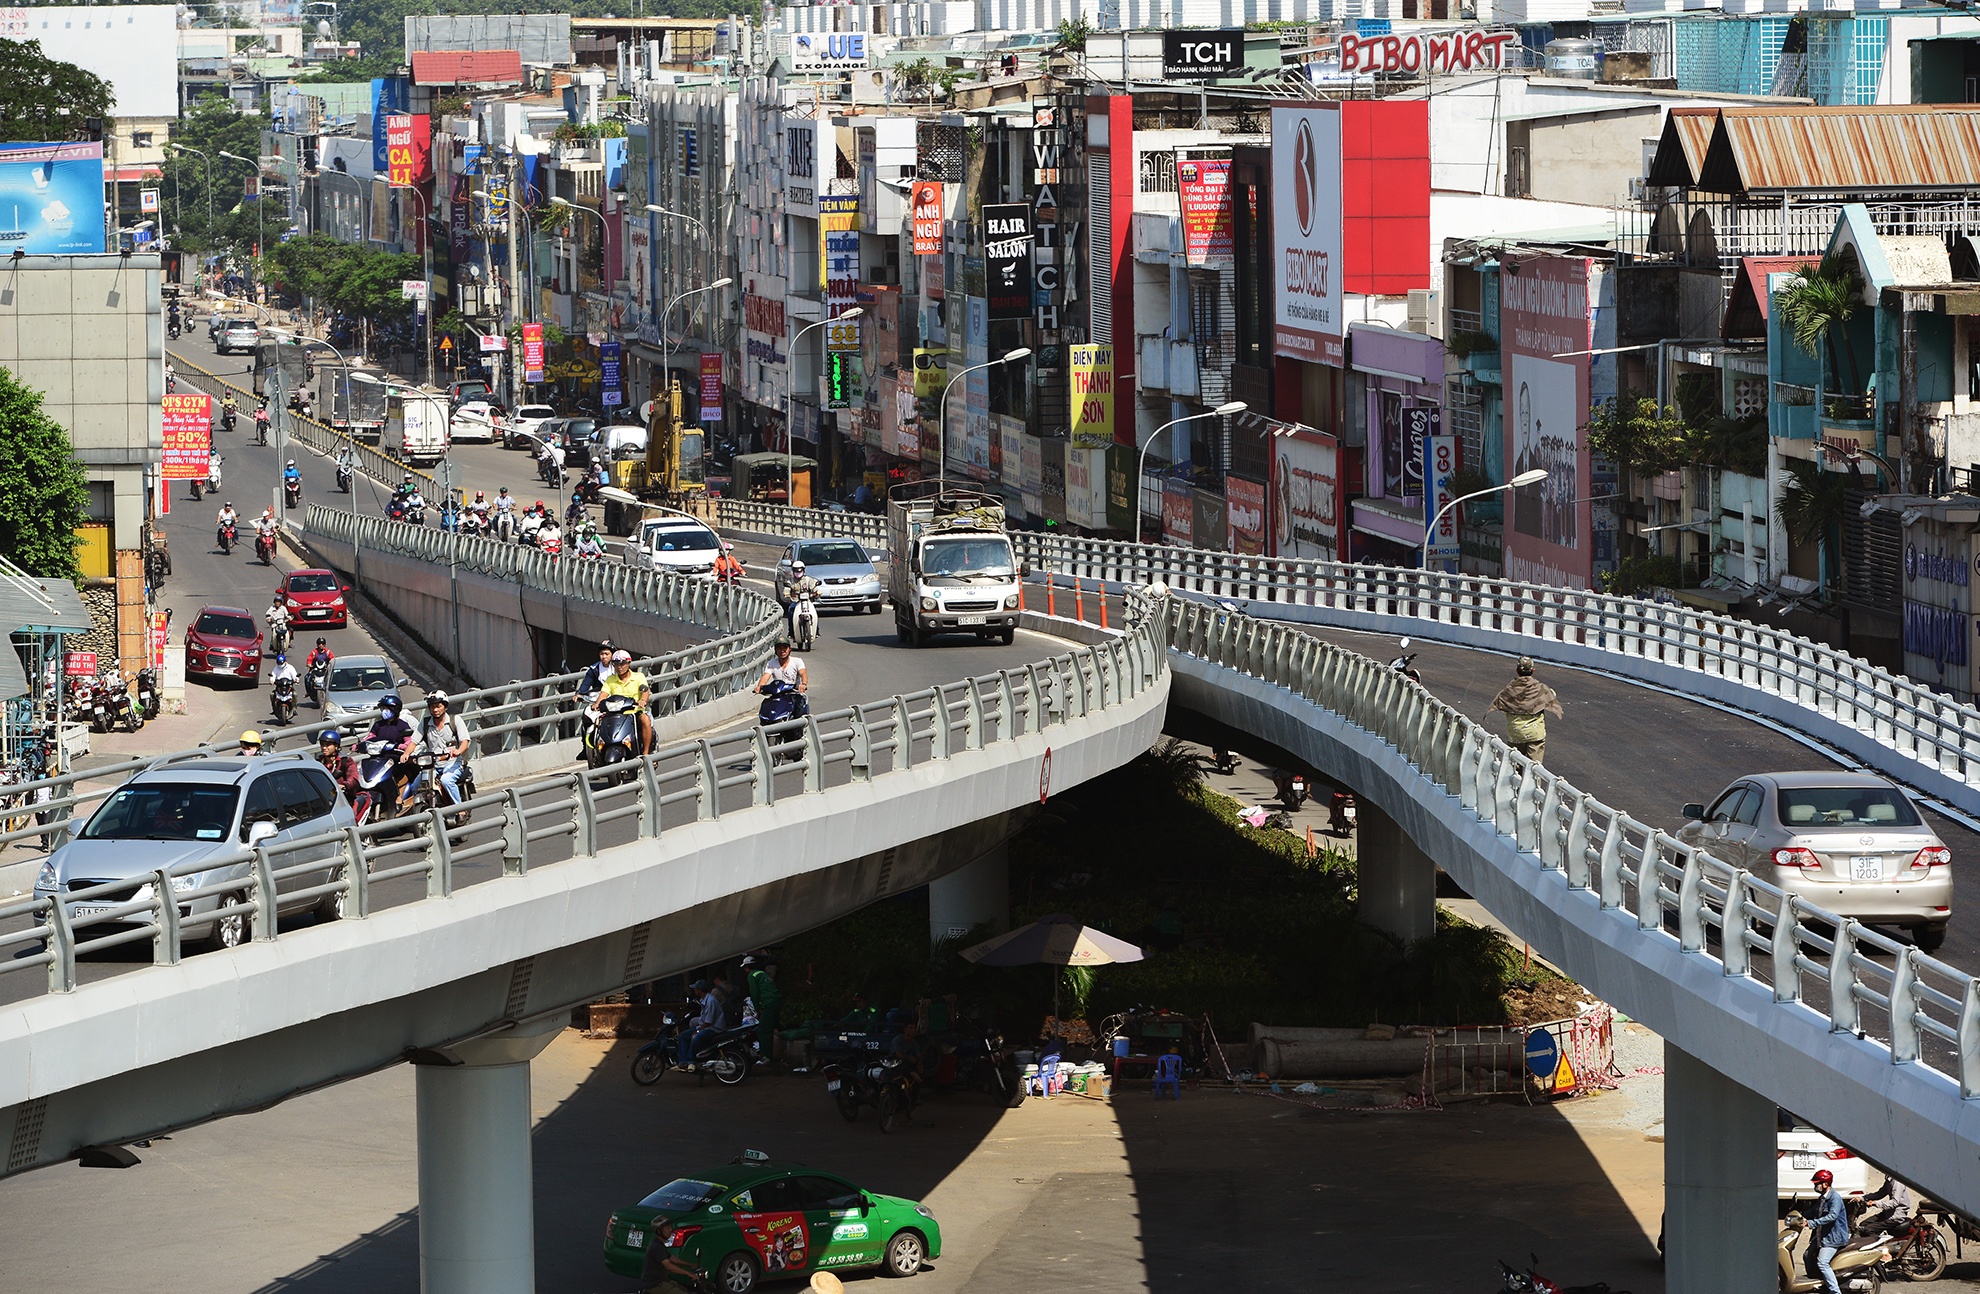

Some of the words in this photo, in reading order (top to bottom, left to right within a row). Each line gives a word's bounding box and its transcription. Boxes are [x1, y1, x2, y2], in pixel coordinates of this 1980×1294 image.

[1341, 35, 1421, 73] BIBO
[1429, 33, 1513, 73] MART
[389, 116, 411, 128] ANH
[389, 131, 412, 145] NGỮ
[389, 149, 412, 165] CA
[393, 168, 411, 185] LI
[820, 199, 838, 213] TIỆM
[838, 198, 858, 211] VÀNG
[916, 204, 940, 220] ANH
[916, 220, 941, 238] NGỮ
[987, 218, 1027, 235] HAIR
[915, 242, 942, 251] BRAVE
[987, 240, 1027, 259] SALON
[831, 324, 857, 342] 68
[1073, 347, 1092, 368] ĐIỆN
[1094, 346, 1112, 365] MÁY
[1074, 372, 1111, 394] THANH
[184, 396, 207, 408] GYM
[1082, 398, 1105, 423] SƠN
[177, 432, 207, 442] 50%
[1437, 445, 1450, 473] GO
[1438, 492, 1452, 538] SHOP
[1858, 858, 1875, 868] 31F
[1855, 870, 1878, 879] 1203
[1052, 950, 1079, 958] BIDV
[767, 1216, 793, 1231] KORENO
